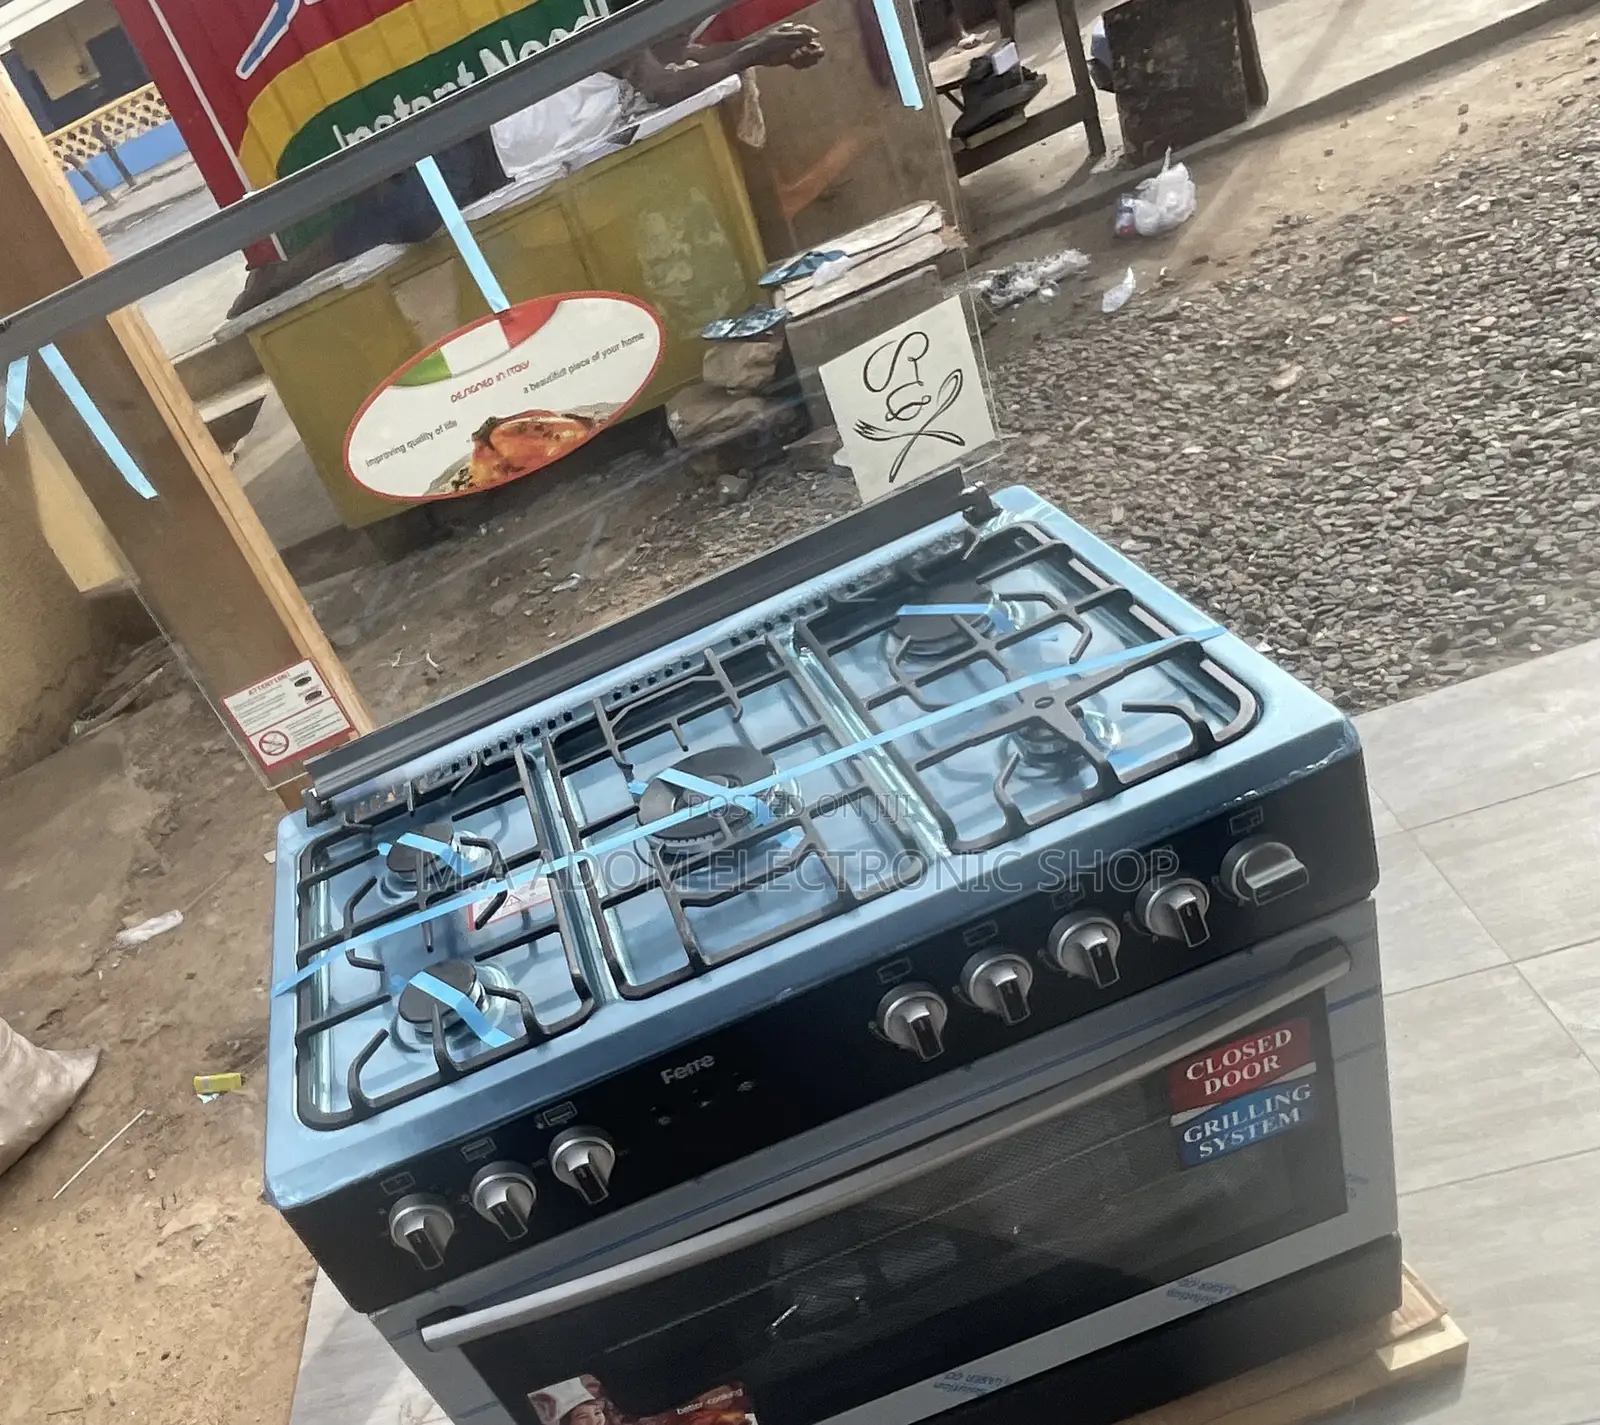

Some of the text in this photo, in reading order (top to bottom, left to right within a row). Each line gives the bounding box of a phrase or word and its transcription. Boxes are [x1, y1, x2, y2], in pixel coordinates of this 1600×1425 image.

[528, 369, 567, 391] beautiful
[567, 359, 591, 375] piece
[591, 351, 600, 363] of
[601, 344, 621, 360] your
[620, 332, 645, 349] home
[407, 431, 434, 450] quality
[435, 424, 443, 435] of
[660, 1055, 715, 1084] Ferre
[1186, 1029, 1292, 1080] CLOSED
[1204, 1055, 1281, 1096] DOOR
[1184, 1083, 1312, 1143] GRILLING
[1200, 1107, 1300, 1158] SYSTEM
